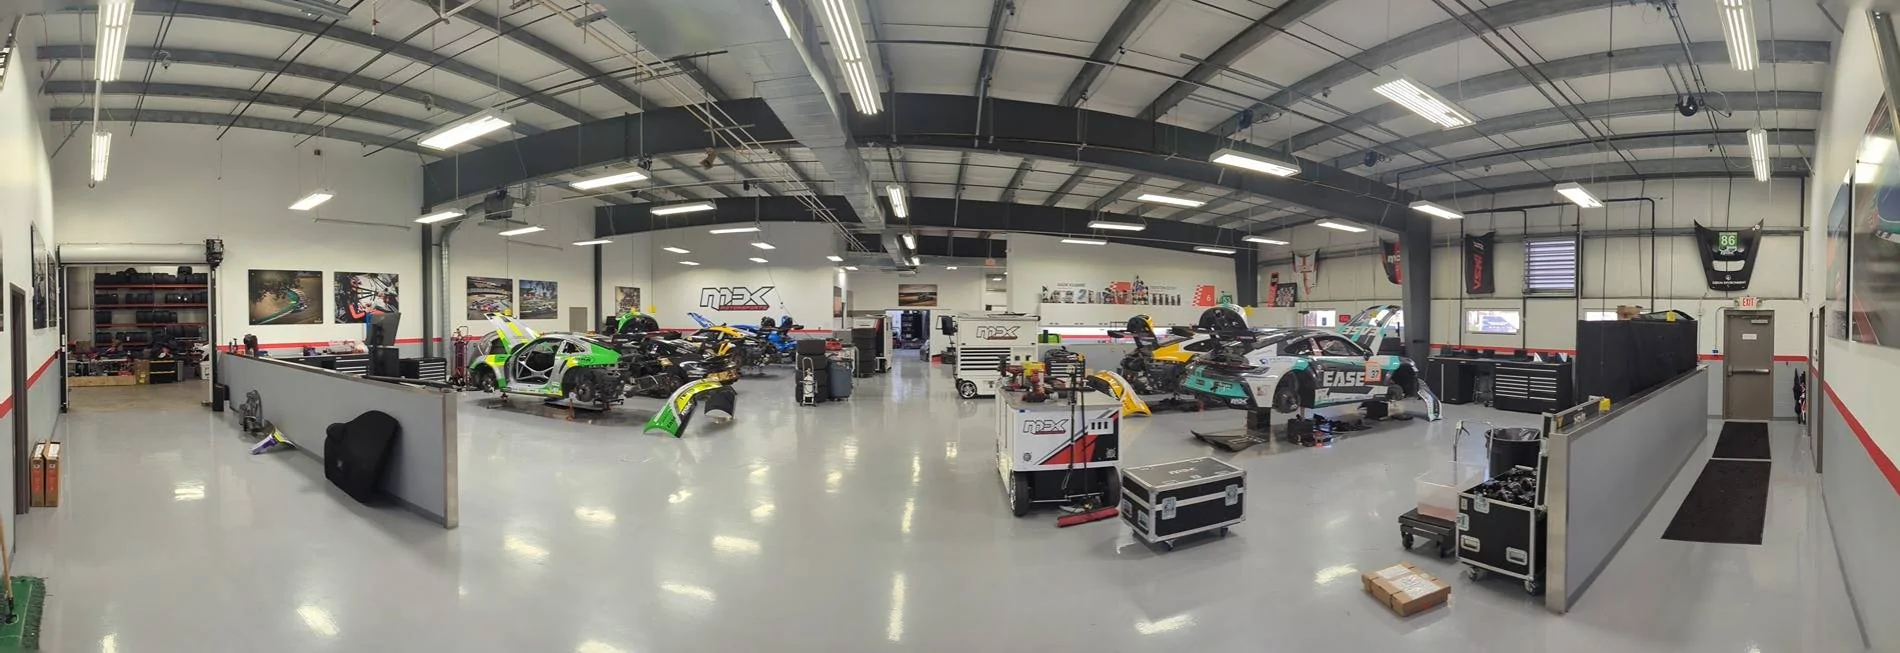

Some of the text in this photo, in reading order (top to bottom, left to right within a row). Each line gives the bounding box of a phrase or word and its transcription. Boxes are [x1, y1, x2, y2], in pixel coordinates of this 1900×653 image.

[1721, 235, 1736, 246] 86
[1742, 298, 1754, 307] EXIT
[1323, 371, 1366, 387] EASE
